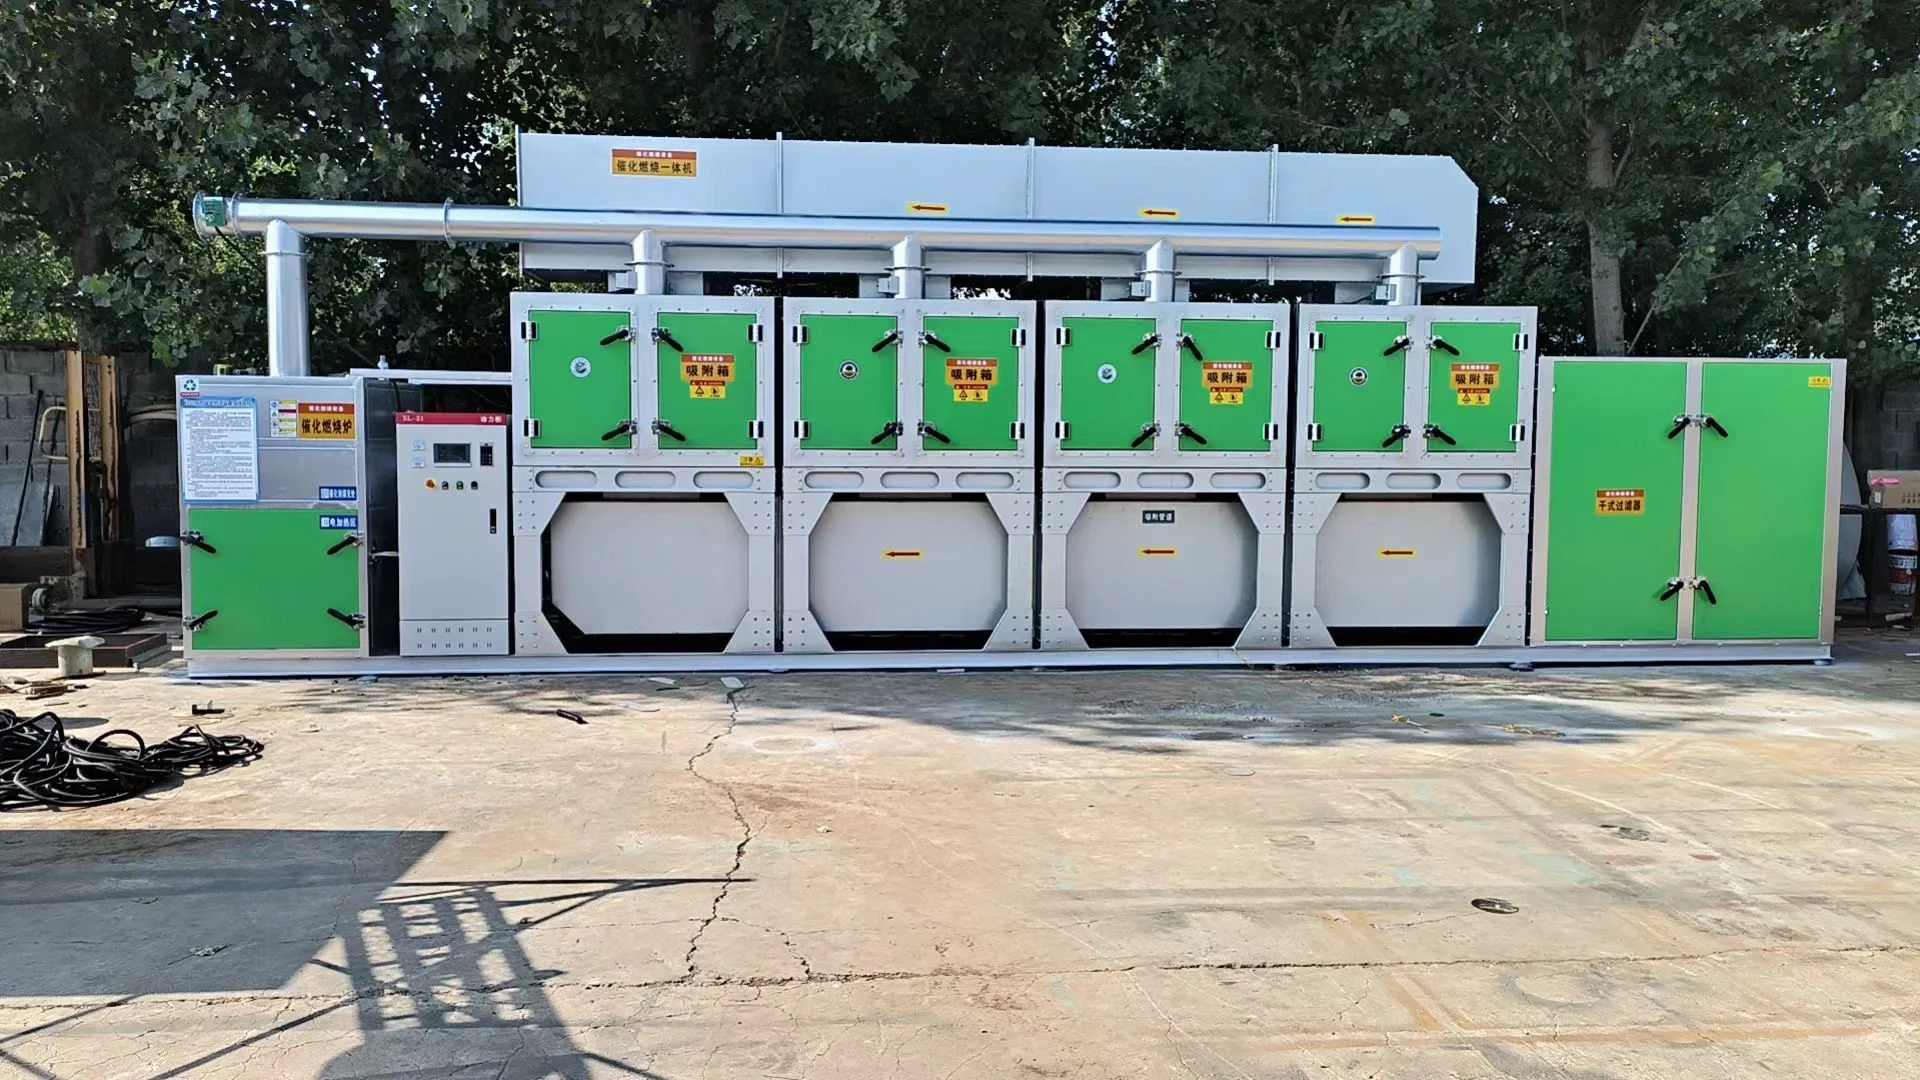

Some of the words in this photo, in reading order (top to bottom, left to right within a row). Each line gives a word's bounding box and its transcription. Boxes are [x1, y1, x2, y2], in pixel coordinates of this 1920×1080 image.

[617, 160, 692, 174] 催化燃烧一体机
[686, 365, 729, 377] 吸附箱
[951, 369, 992, 381] 吸附箱
[1207, 372, 1247, 384] 吸附箱
[1455, 373, 1494, 385] 吸附箱
[301, 418, 352, 434] 催化燃烧炉
[1598, 500, 1641, 512] 干式过滤器
